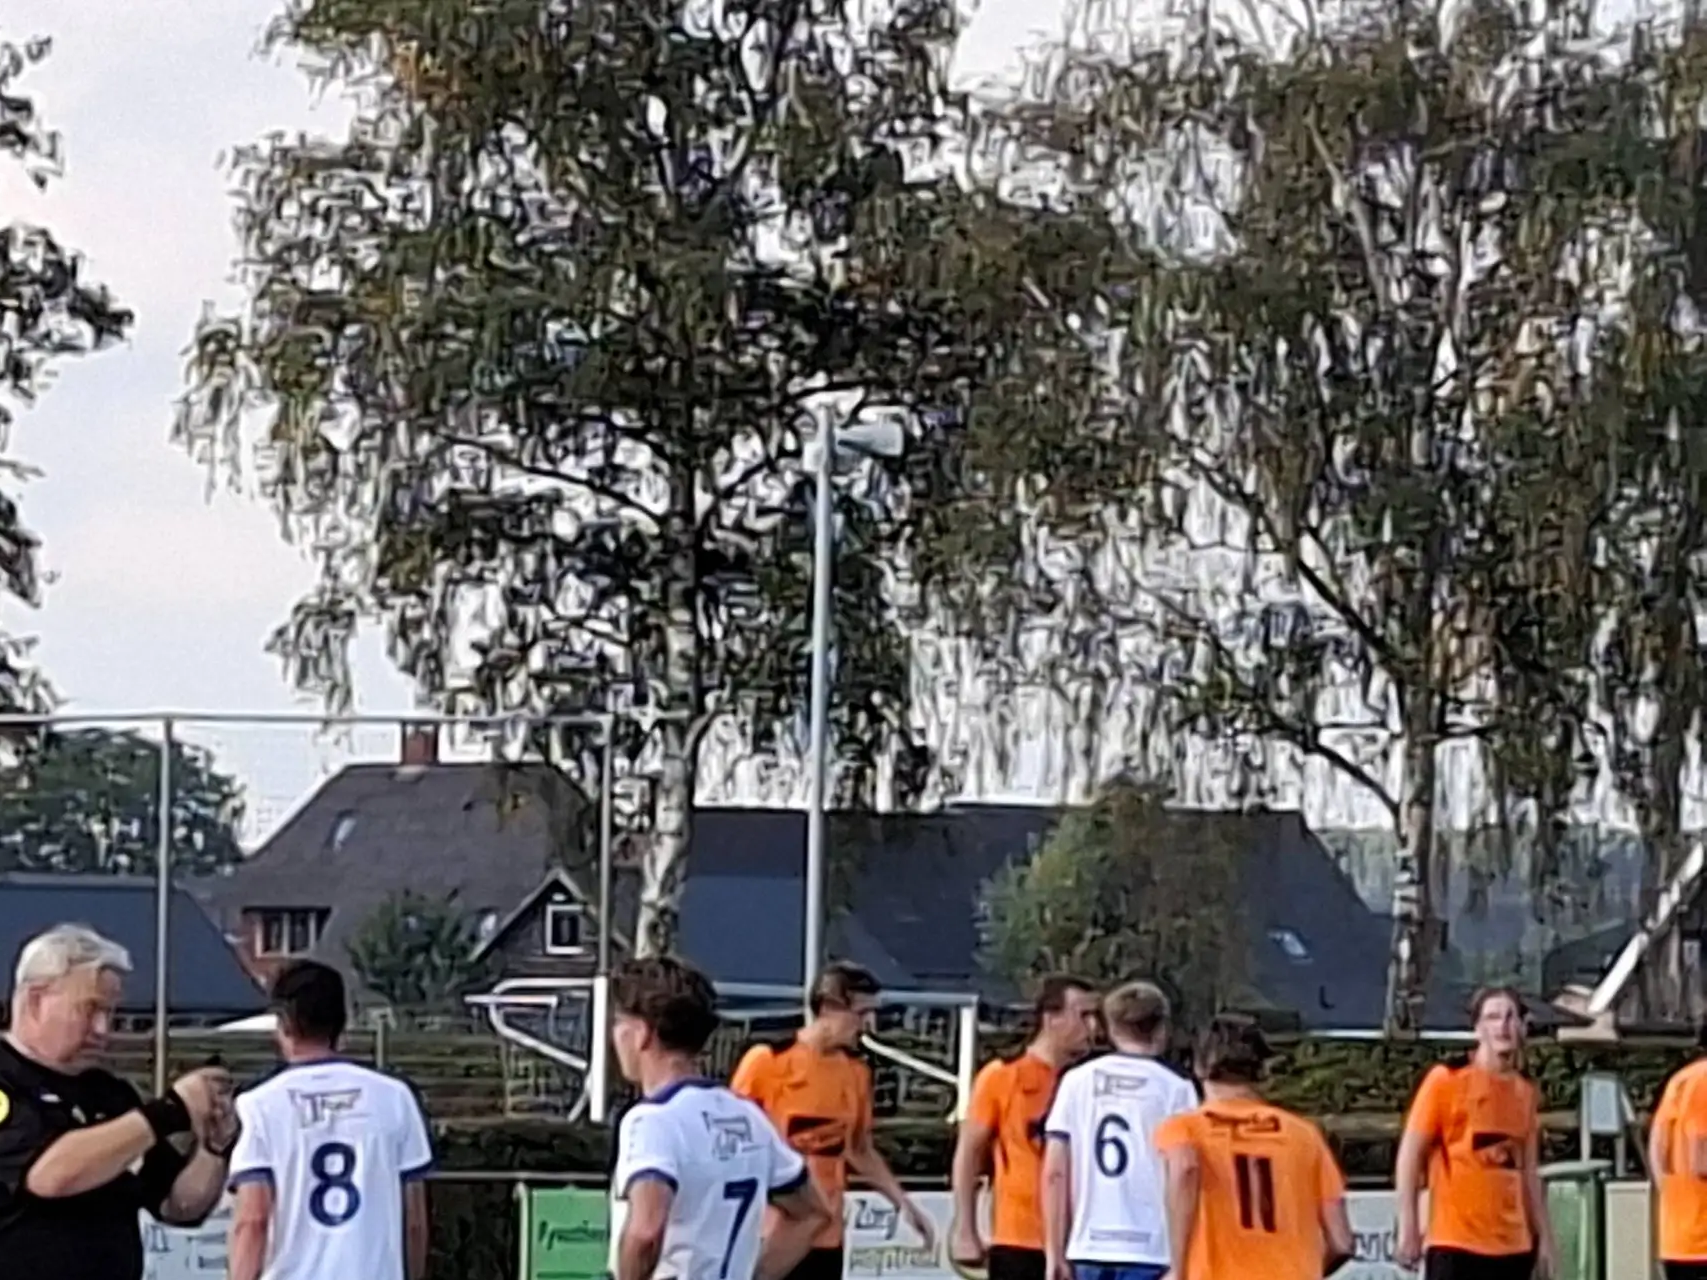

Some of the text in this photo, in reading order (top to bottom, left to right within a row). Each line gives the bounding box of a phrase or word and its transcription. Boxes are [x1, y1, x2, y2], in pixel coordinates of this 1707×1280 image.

[309, 1141, 361, 1227] 8
[1095, 1113, 1131, 1178] 6
[719, 1177, 759, 1280] 7
[1235, 1154, 1277, 1233] 11
